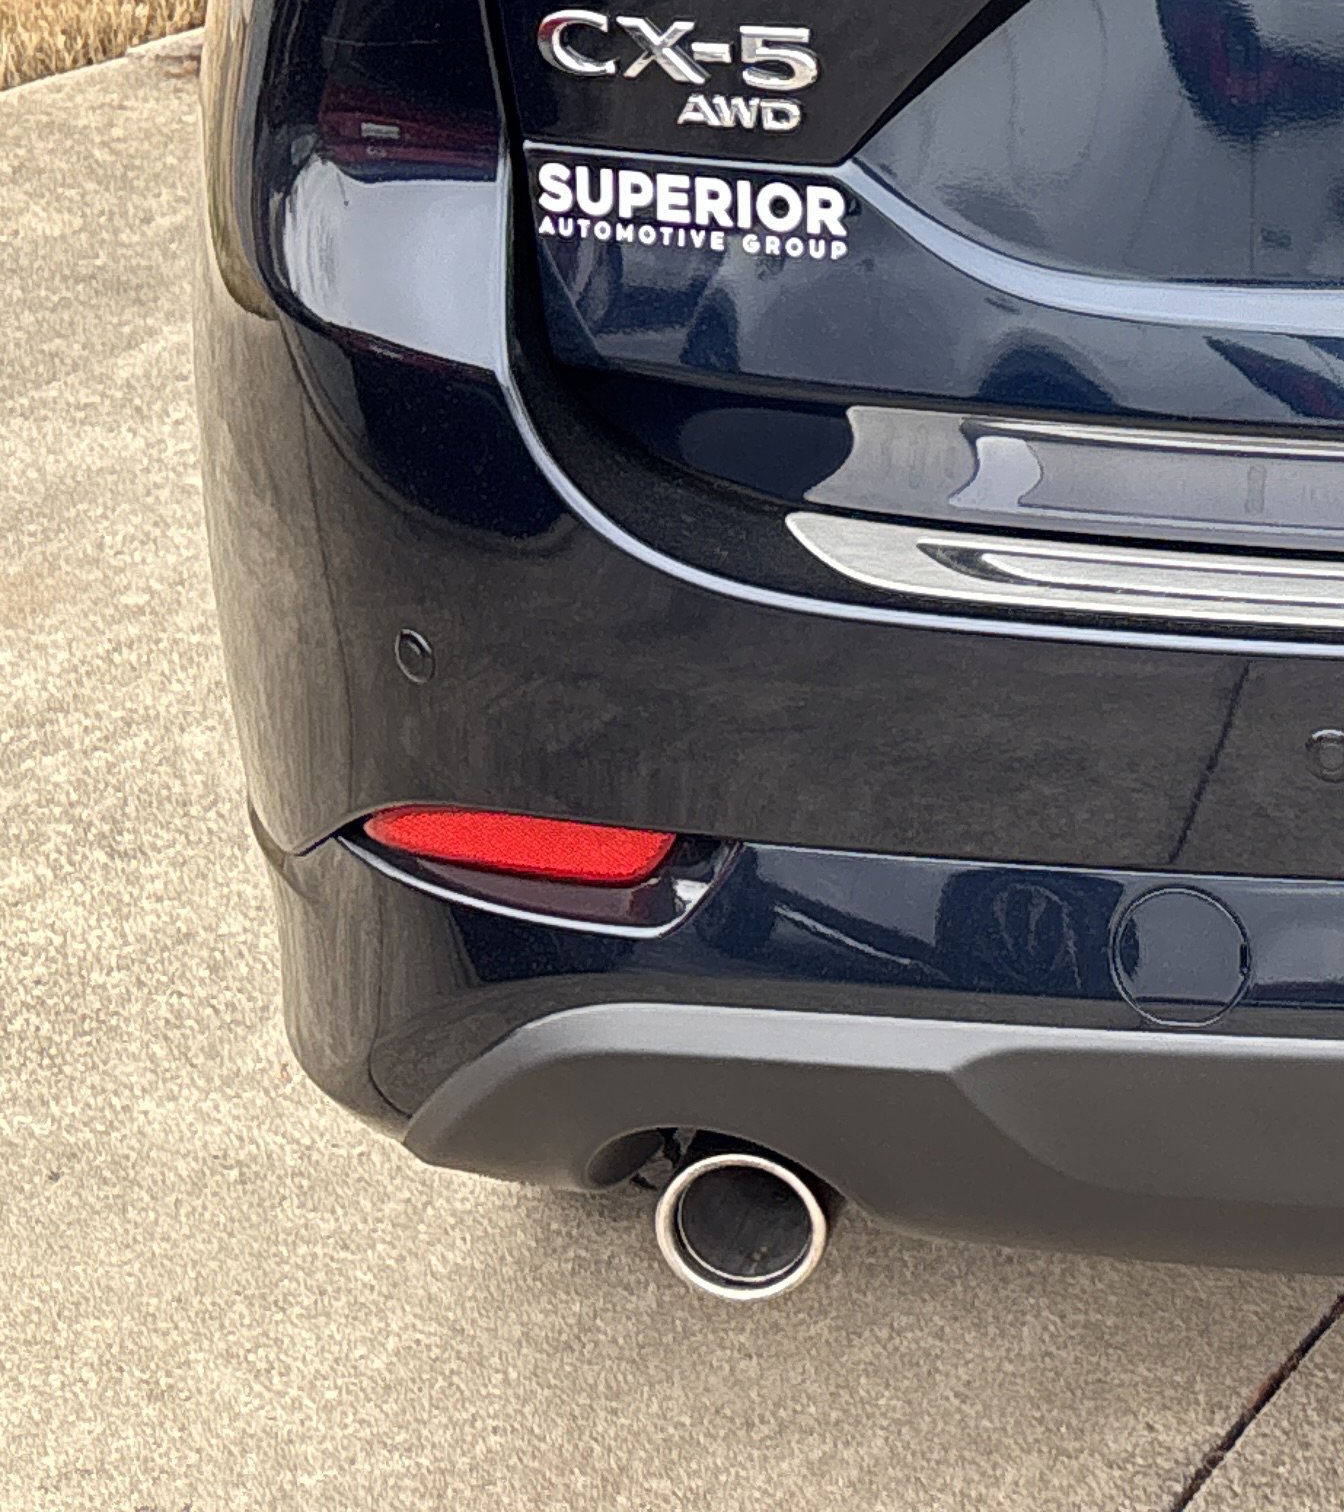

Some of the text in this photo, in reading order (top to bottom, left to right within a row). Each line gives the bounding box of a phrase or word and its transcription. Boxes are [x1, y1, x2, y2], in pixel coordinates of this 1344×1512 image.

[536, 9, 823, 93] CX-5
[676, 92, 803, 132] AWD
[537, 161, 848, 238] SUPERIOR
[537, 214, 850, 261] AUTOMOTIVE GROUP
